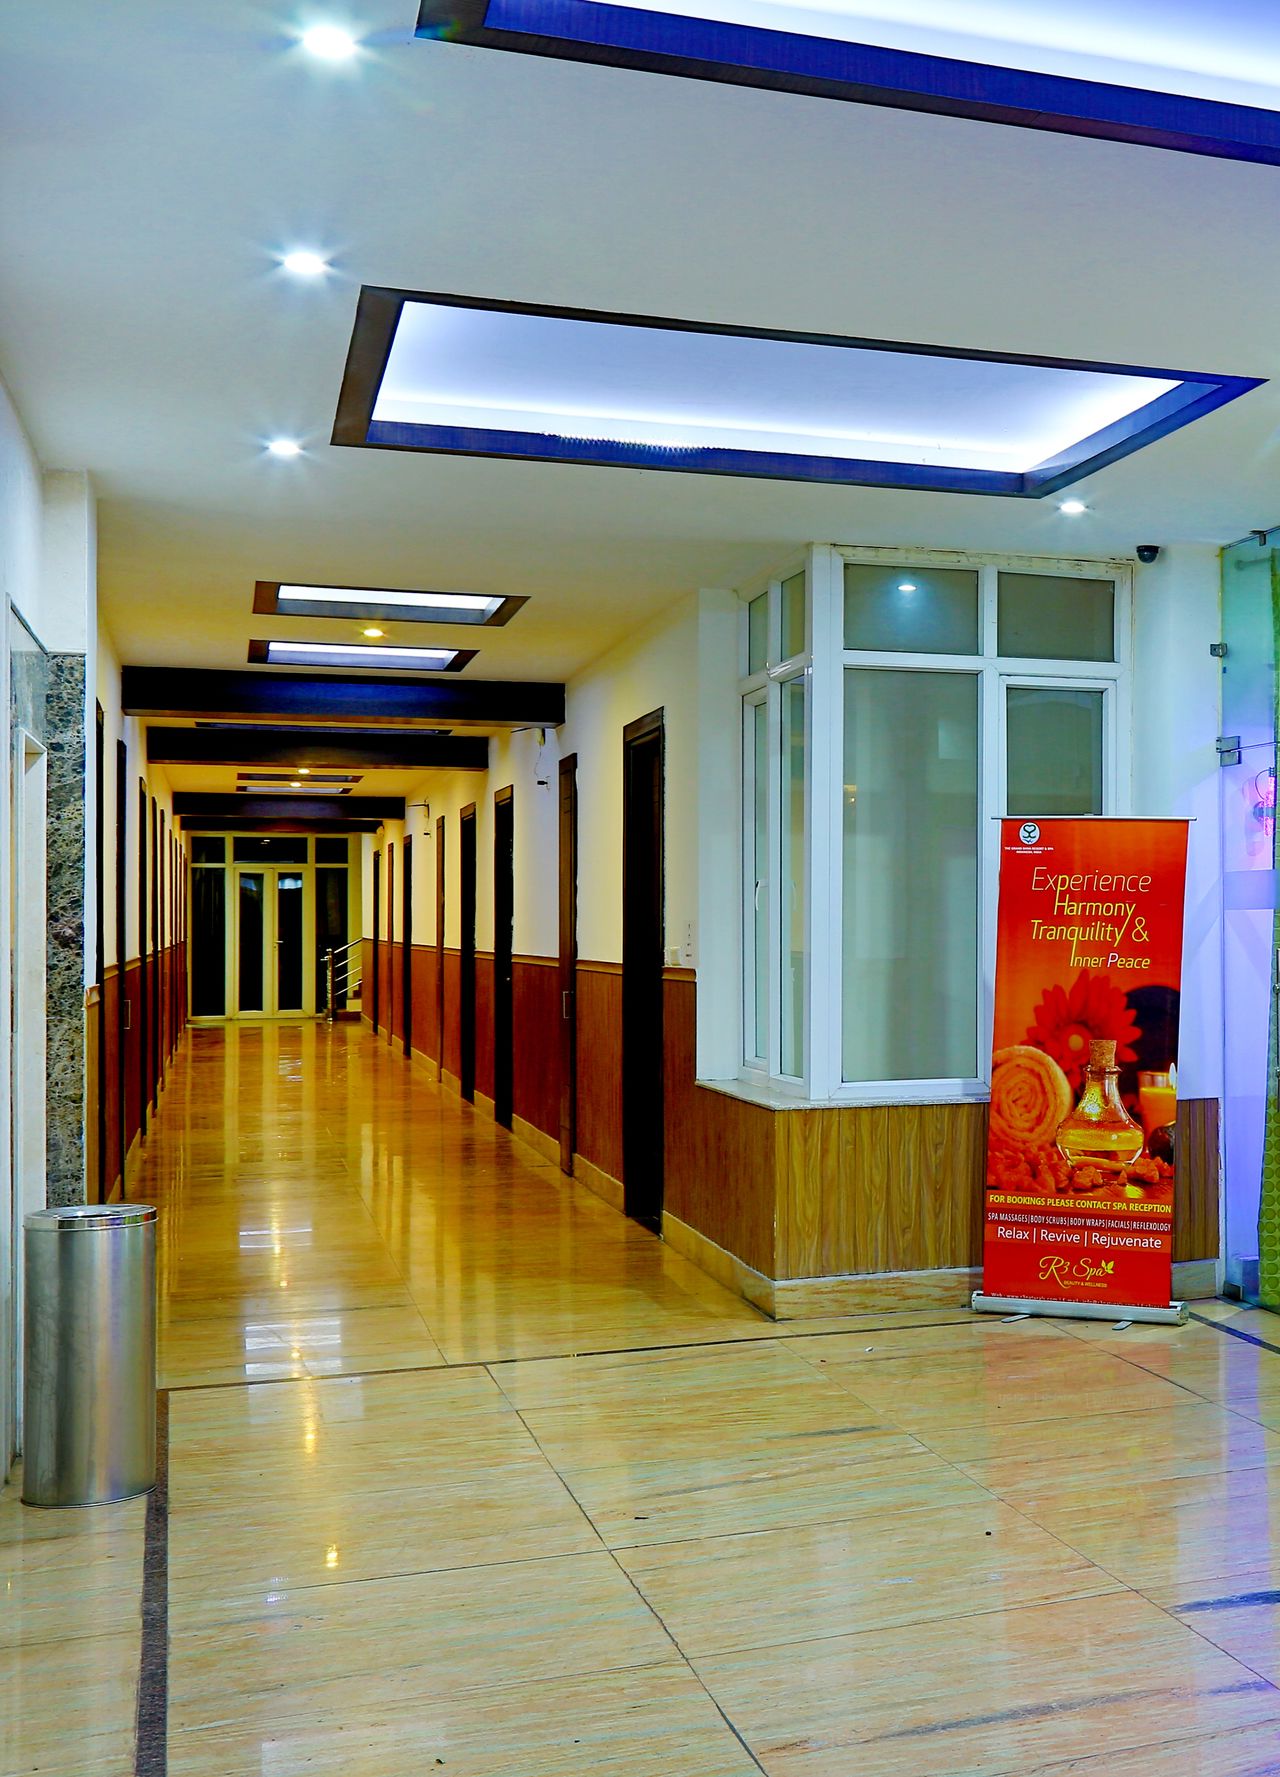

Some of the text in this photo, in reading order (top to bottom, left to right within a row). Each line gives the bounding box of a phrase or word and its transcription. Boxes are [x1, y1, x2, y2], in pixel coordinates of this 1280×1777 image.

[1031, 866, 1152, 895] Experience
[1054, 893, 1136, 919] Harmony
[1031, 916, 1150, 947] Tranquility &
[1069, 950, 1151, 969] Inner Peace
[989, 1194, 1172, 1214] FOR BOOKINGS PLEASE CONTACT SPA RECEPTION
[988, 1212, 999, 1221] SPA
[997, 1226, 1162, 1249] Relax Revive Rejuvenate
[1072, 1257, 1107, 1281] Spa
